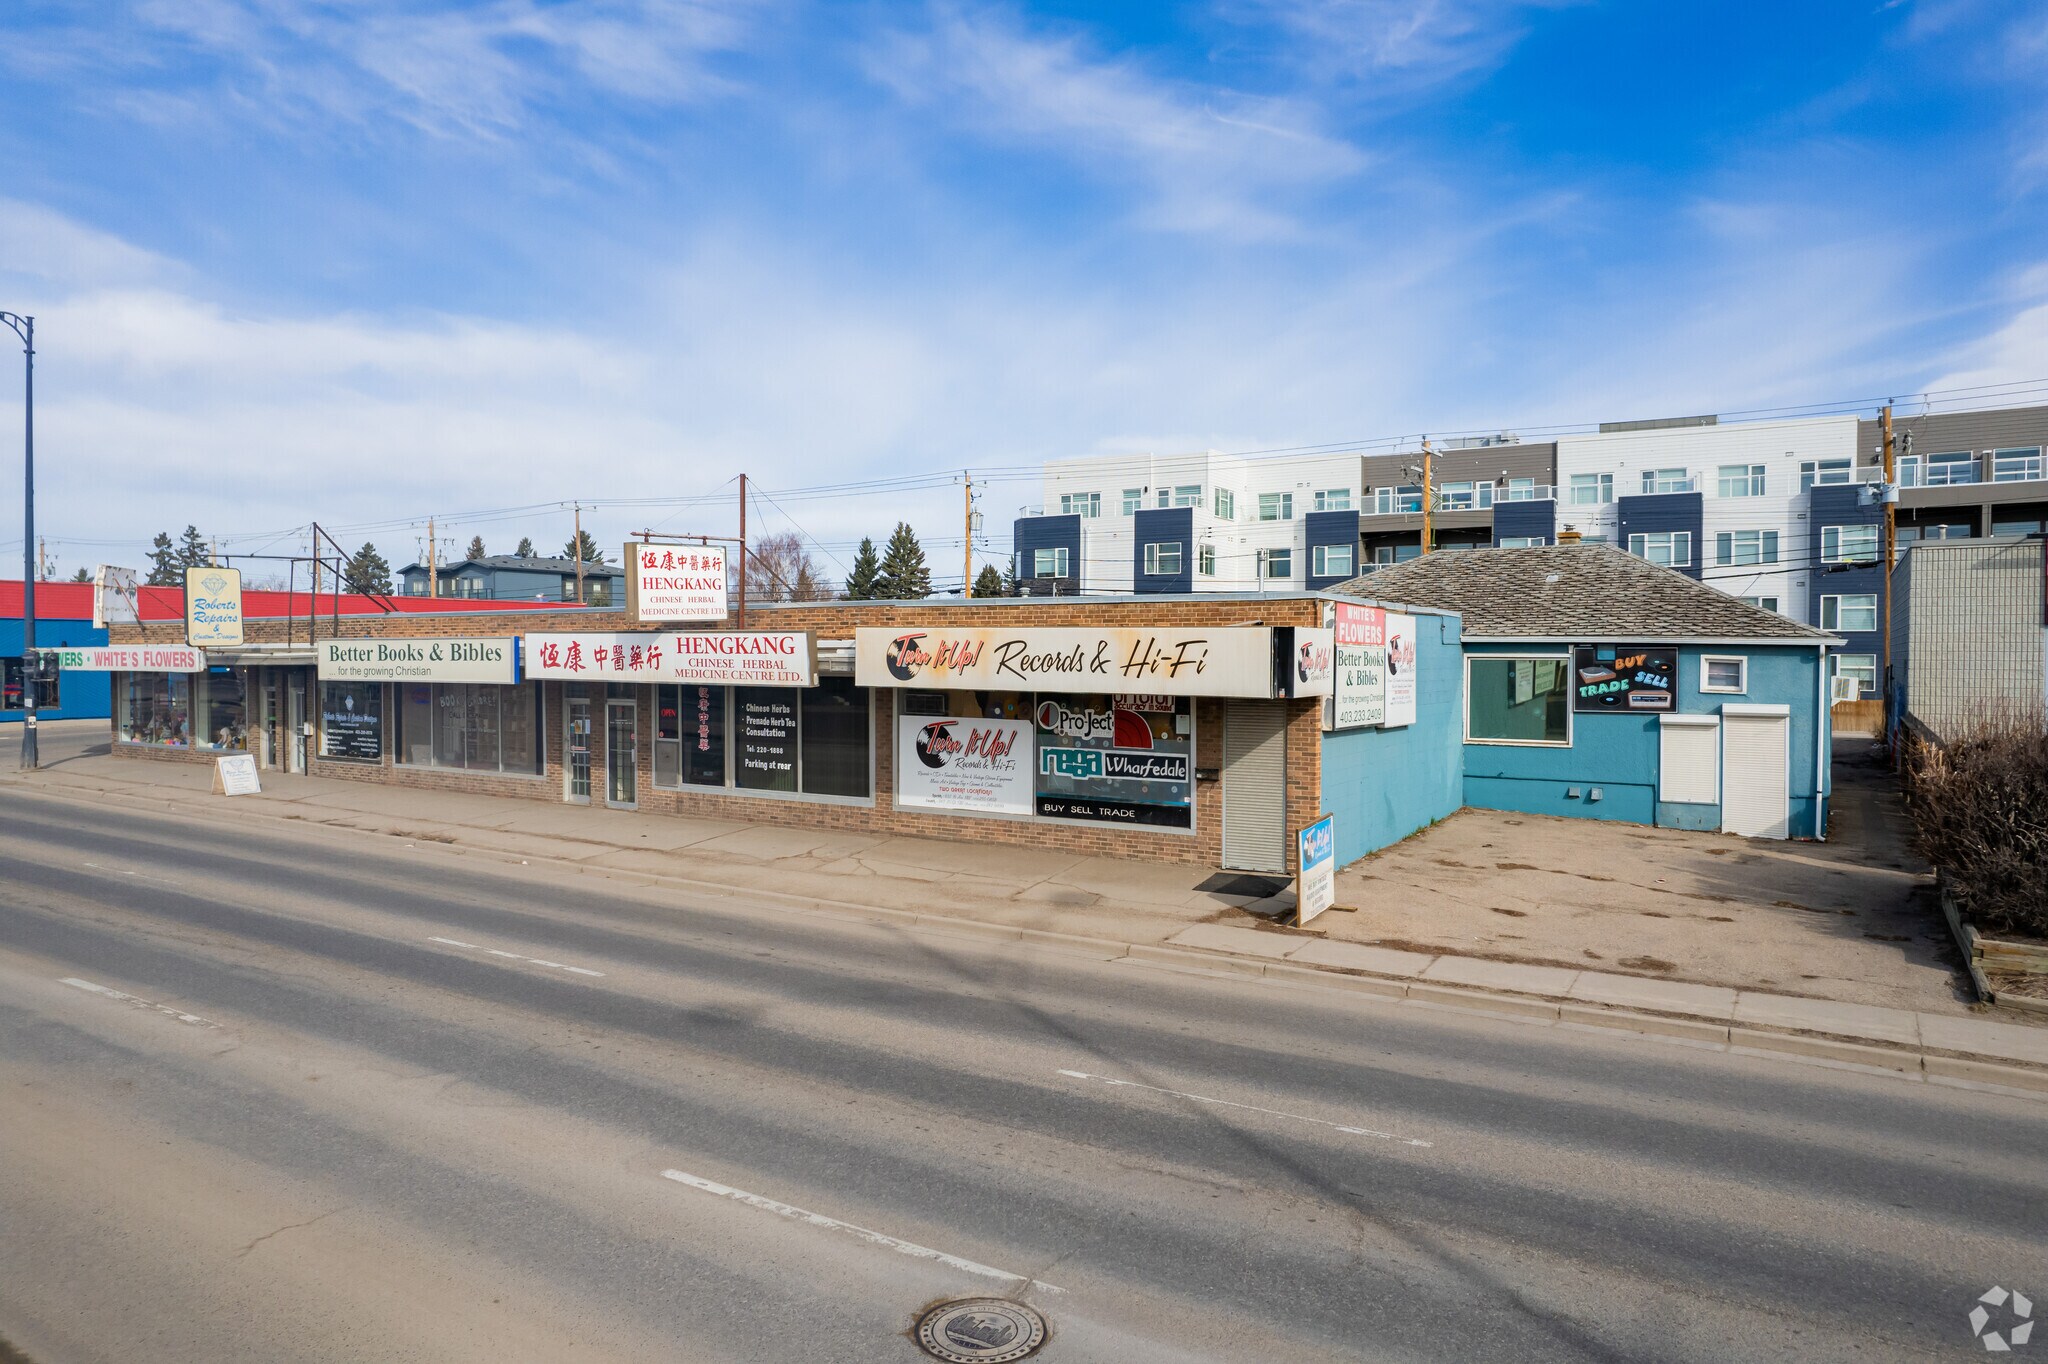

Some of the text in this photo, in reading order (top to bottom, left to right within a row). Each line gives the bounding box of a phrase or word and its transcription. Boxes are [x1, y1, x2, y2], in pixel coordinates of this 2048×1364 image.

[643, 577, 722, 590] HENGKANG
[194, 598, 236, 610] Roberts
[193, 611, 238, 625] Repairs
[641, 608, 679, 616] MEDICINE
[1347, 605, 1375, 622] WHITE'S
[213, 624, 219, 632] &
[1339, 622, 1382, 644] FLOWERS
[216, 632, 238, 640] Designs
[329, 643, 502, 662] Better Books & Bibles
[676, 636, 796, 655] HENGKANG
[93, 651, 139, 668] WHITE'S
[143, 651, 195, 668] FLOWERS
[688, 657, 787, 670] CHINESE HERBAL
[896, 632, 1208, 681] Turn It Up! Records & Hi-Fi
[1338, 650, 1384, 667] Better Books
[1615, 654, 1647, 670] BUY
[338, 666, 348, 676] for
[350, 666, 362, 676] the
[363, 666, 394, 678] growing
[395, 665, 432, 676] Christian
[675, 668, 803, 682] MEDICINE CENTRE LTD.
[1346, 670, 1353, 686] &
[1356, 670, 1378, 686] Bibles
[1634, 671, 1669, 688] SELL
[1579, 678, 1630, 698] TRADE
[746, 703, 790, 713] Chinese Herbs
[1155, 704, 1173, 712] sound
[746, 715, 796, 727] Premade Herb Tea
[1060, 711, 1112, 737] Pro-Ject
[746, 727, 786, 737] Consultation
[926, 720, 1018, 764] Turn It Up!
[745, 758, 792, 771] Parking at rear
[955, 757, 1016, 772] Records & Hi-Fi
[1106, 756, 1186, 777] Wharfedale
[1044, 803, 1135, 818] BUY SELL TRADE
